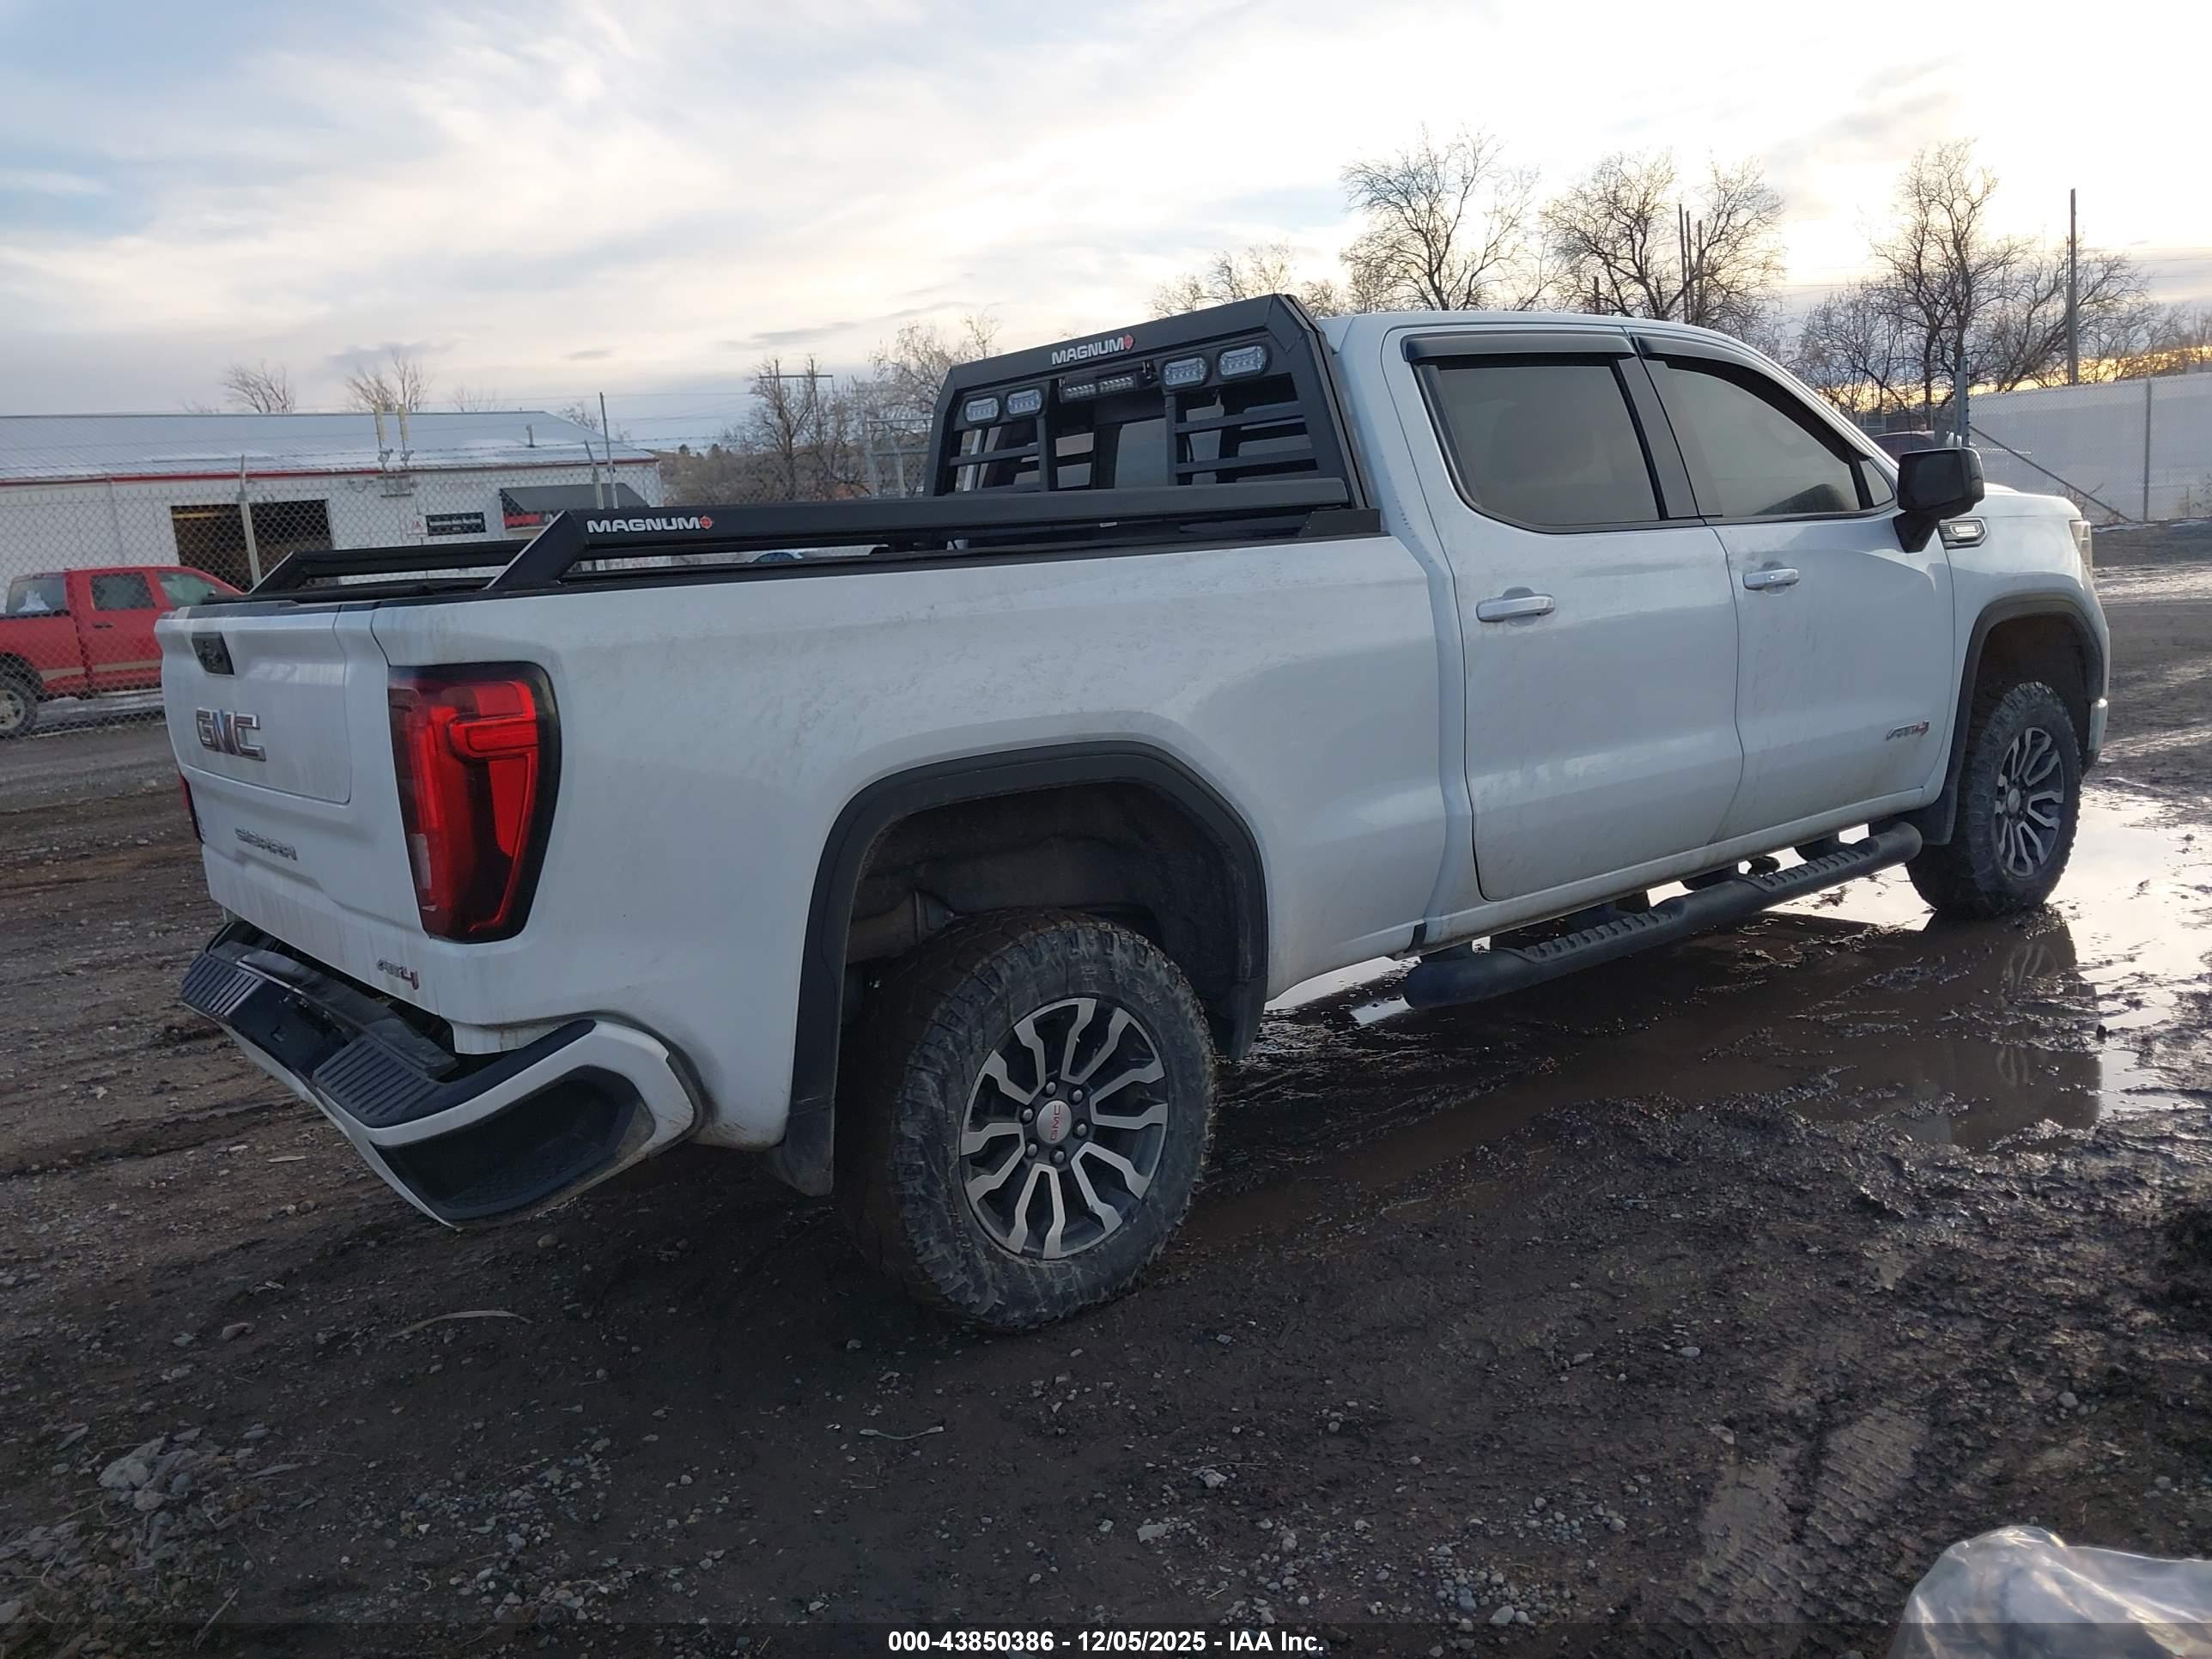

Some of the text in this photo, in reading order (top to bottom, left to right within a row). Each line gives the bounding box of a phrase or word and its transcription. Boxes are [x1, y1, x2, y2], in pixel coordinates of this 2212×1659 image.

[1052, 337, 1125, 365] MAGNUM
[586, 517, 701, 533] MAGNUM
[197, 707, 266, 762] GMC
[377, 959, 419, 990] AT4
[1050, 1104, 1061, 1140] GMC
